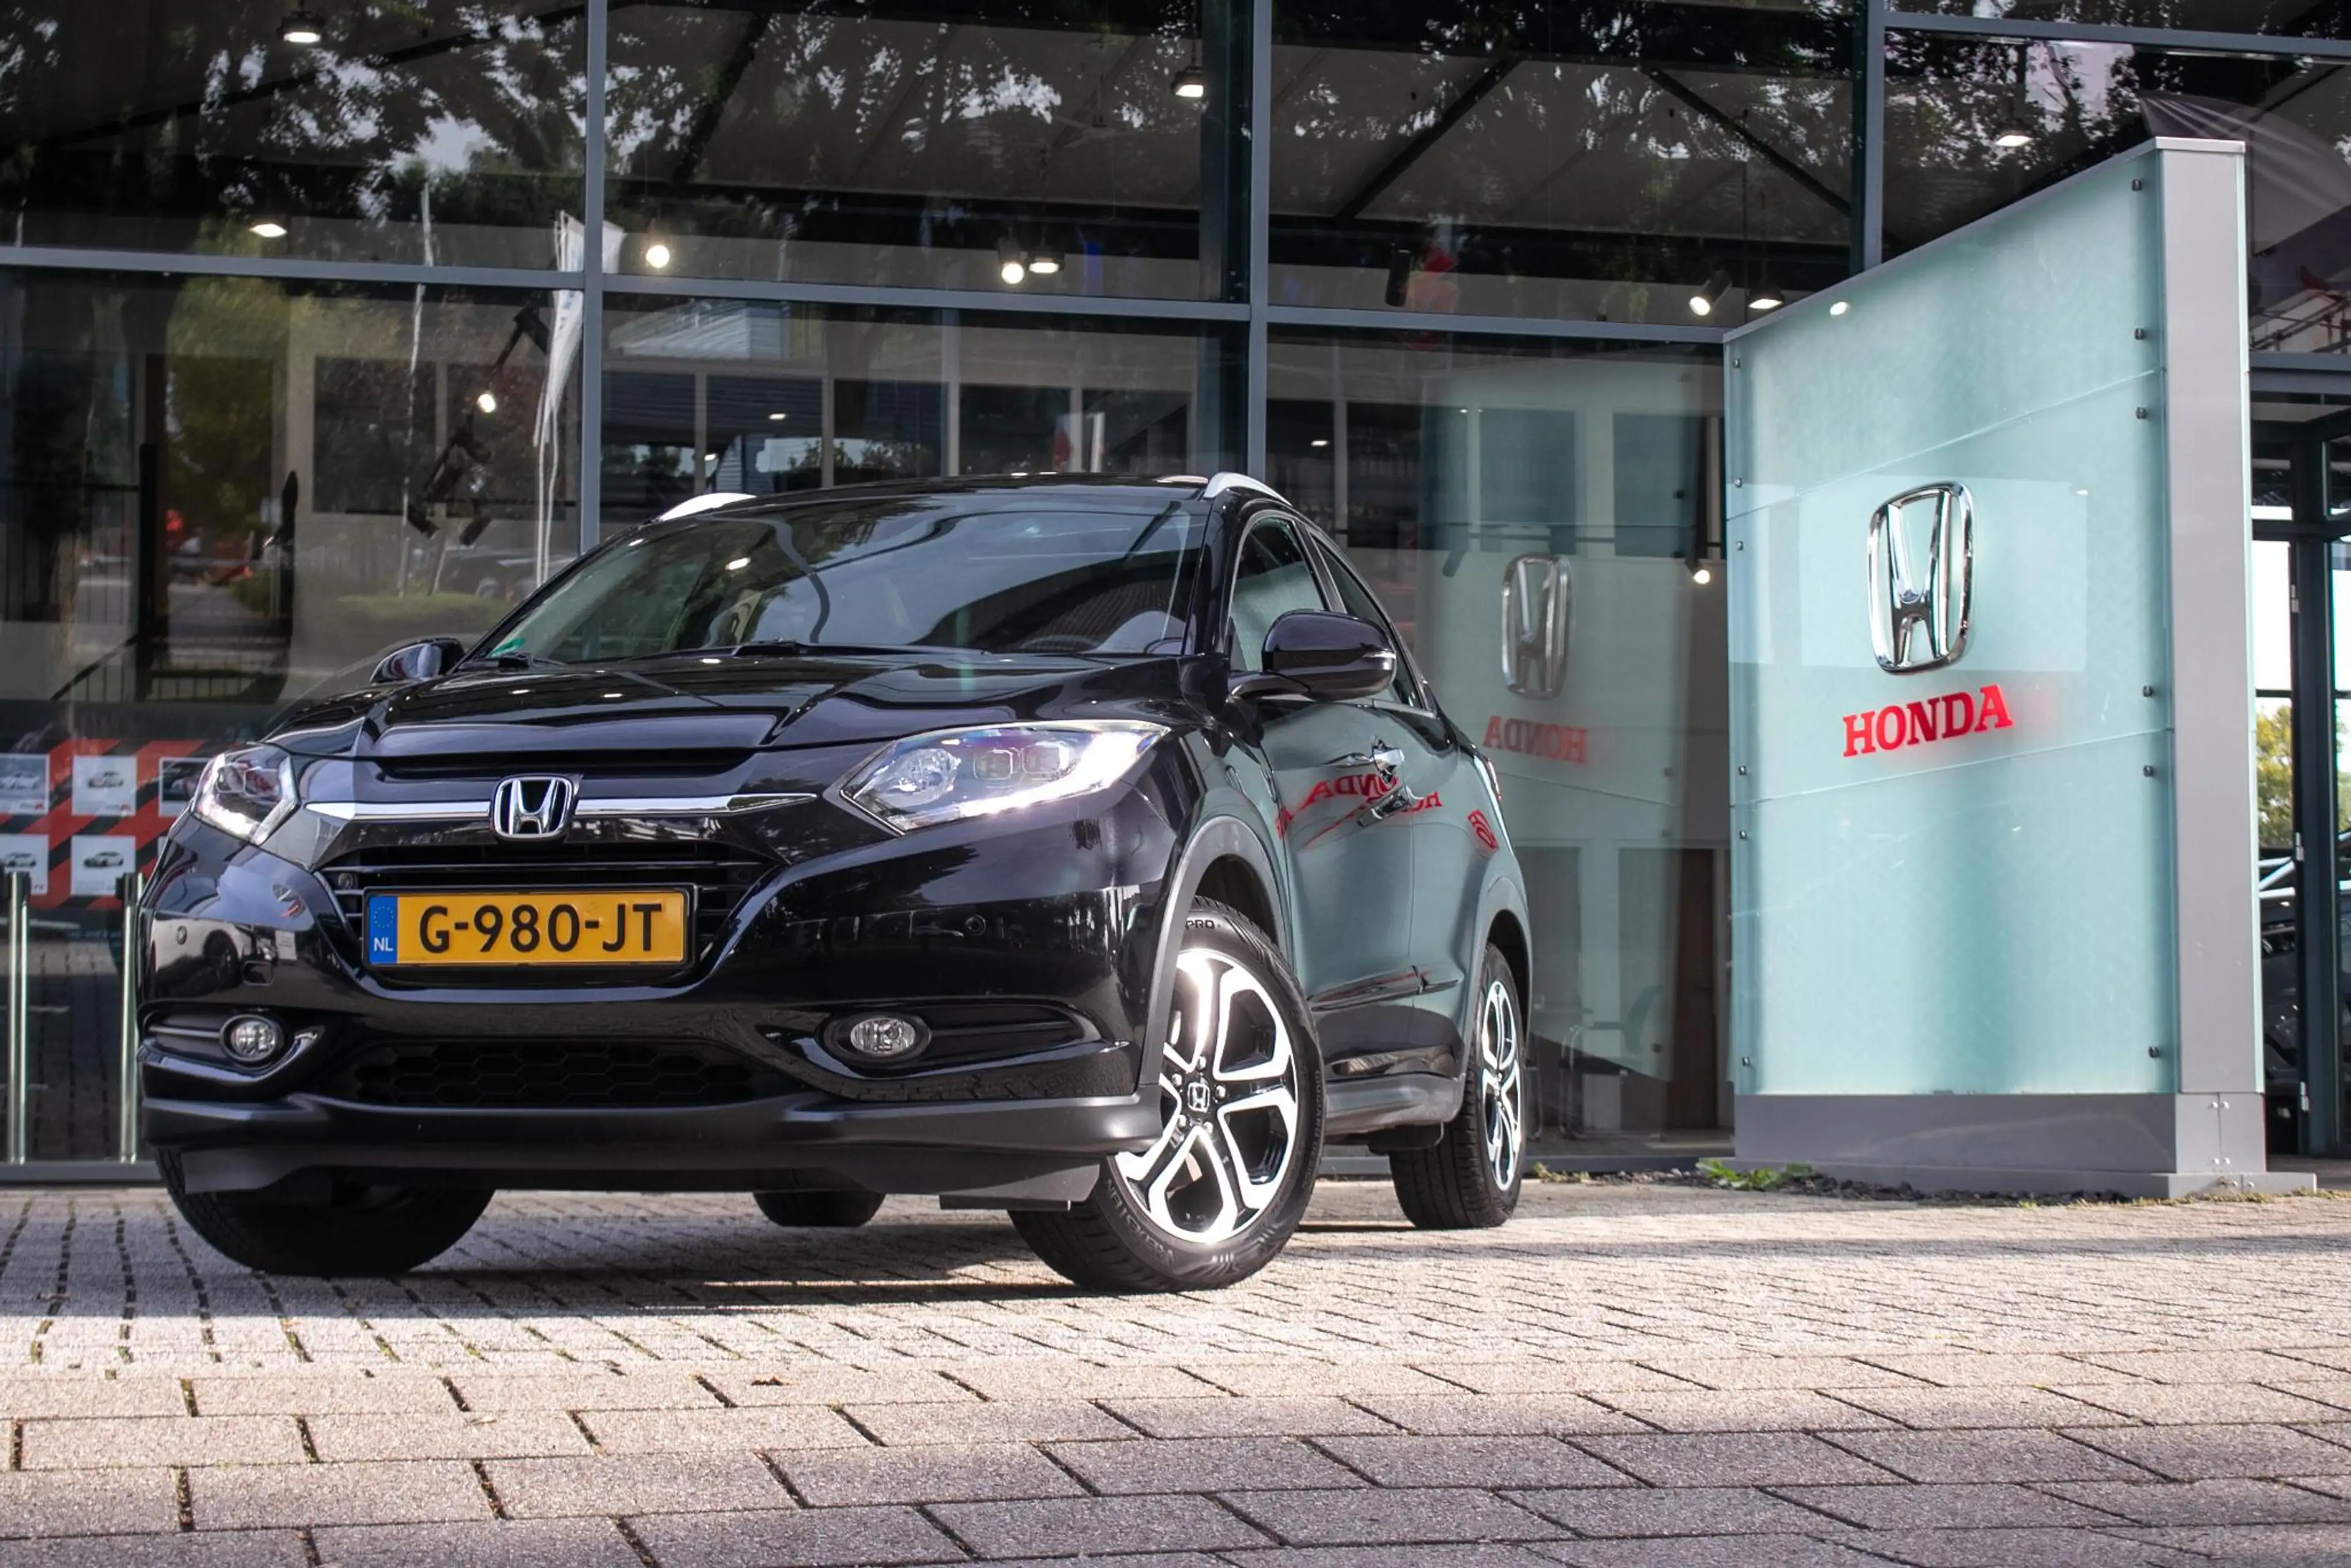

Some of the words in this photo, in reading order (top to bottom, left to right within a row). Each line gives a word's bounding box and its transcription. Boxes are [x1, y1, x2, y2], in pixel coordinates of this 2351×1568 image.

[1843, 684, 2014, 757] HONDA
[419, 903, 662, 953] G-980-JT
[1185, 920, 1215, 930] PRO
[374, 937, 394, 952] NL
